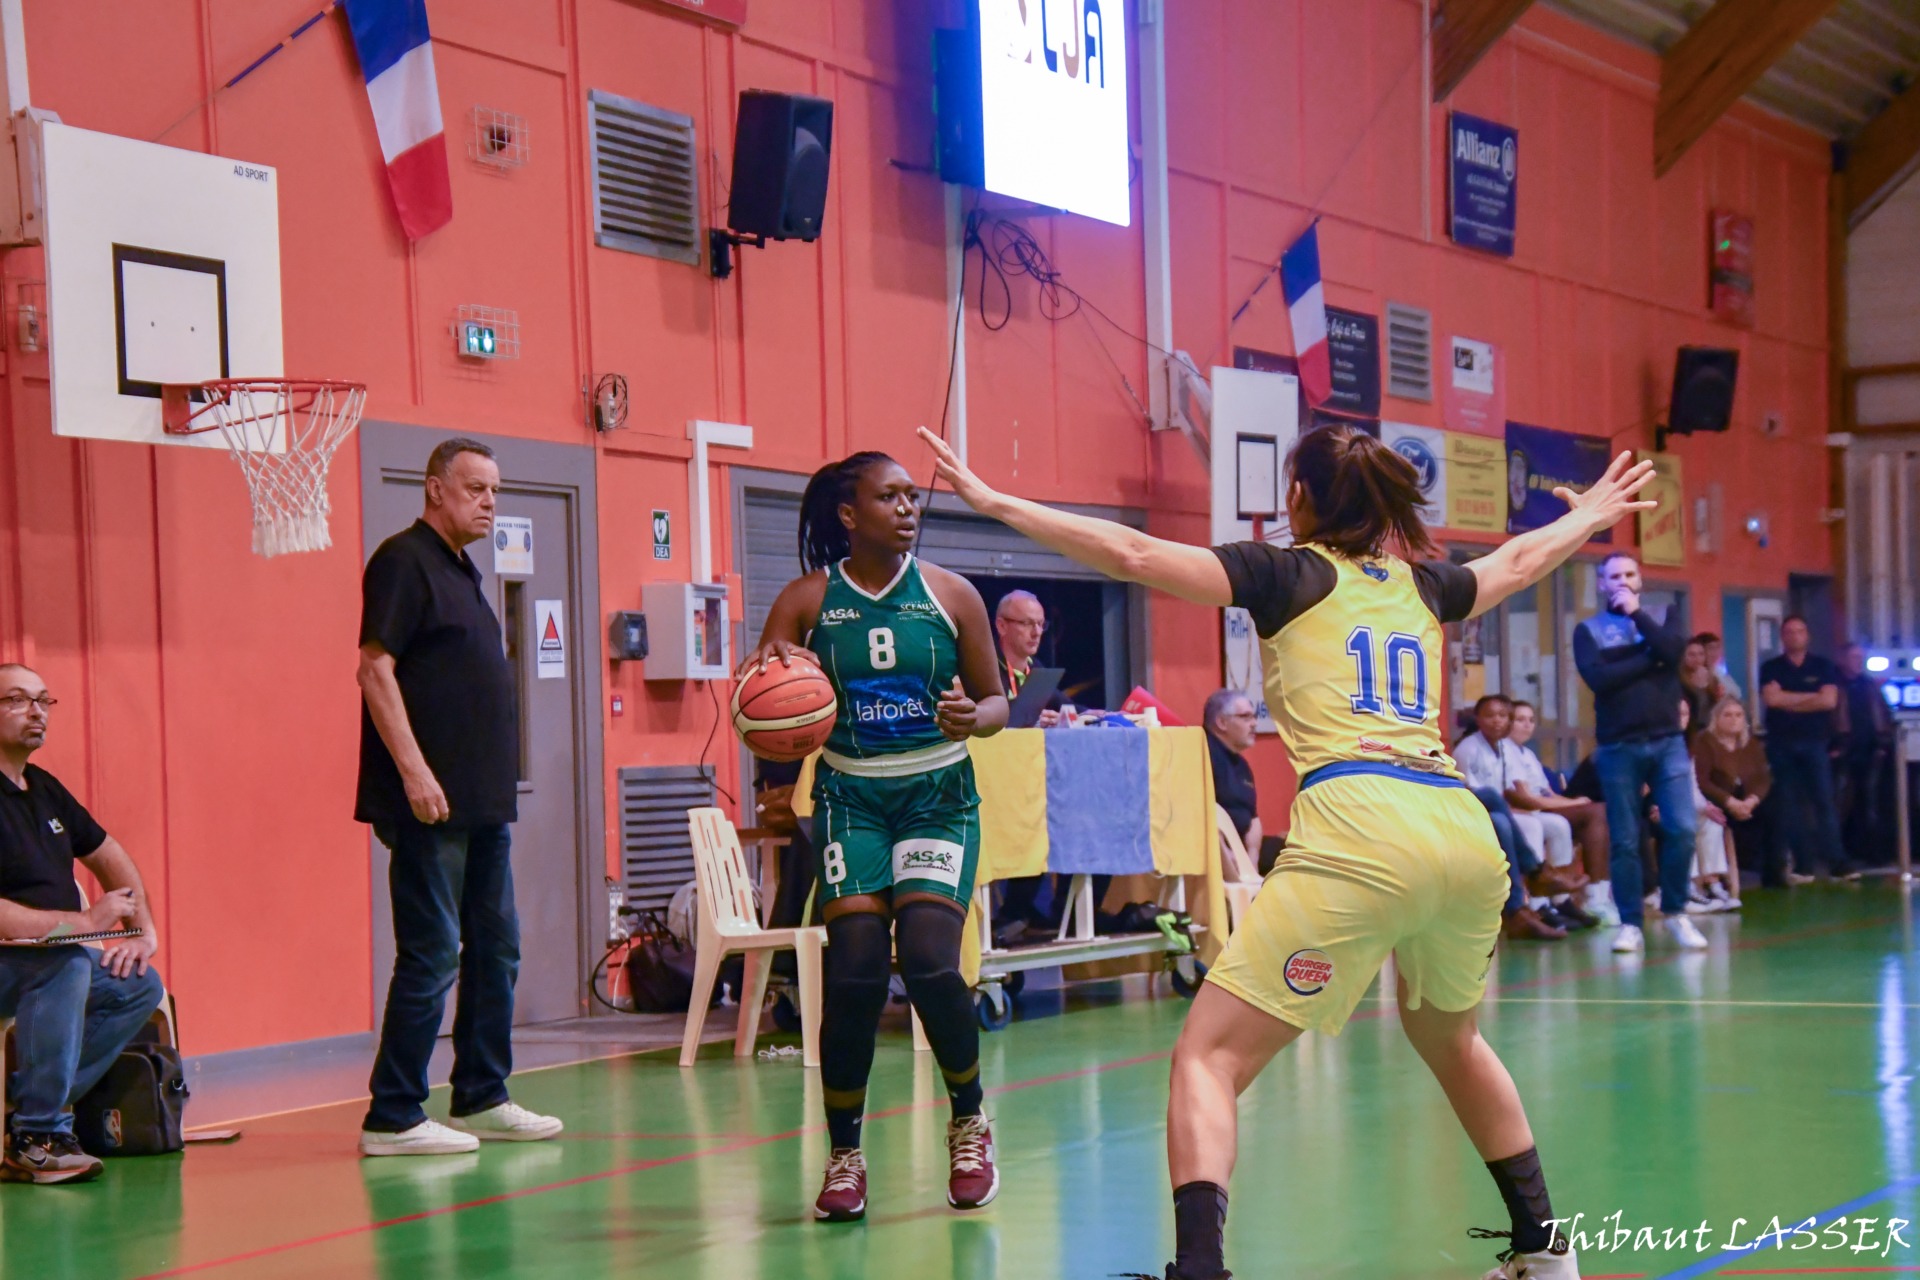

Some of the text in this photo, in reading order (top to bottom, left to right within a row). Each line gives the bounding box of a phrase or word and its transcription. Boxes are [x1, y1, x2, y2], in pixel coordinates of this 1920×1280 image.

[1457, 128, 1501, 169] Allianz
[233, 165, 269, 182] AD SPORT
[655, 547, 669, 558] DEA
[868, 627, 897, 670] 8
[1345, 625, 1428, 725] 10
[856, 697, 929, 722] laforêt
[823, 842, 847, 885] 8
[1286, 967, 1333, 984] QUEEN
[1290, 958, 1332, 972] BURGER
